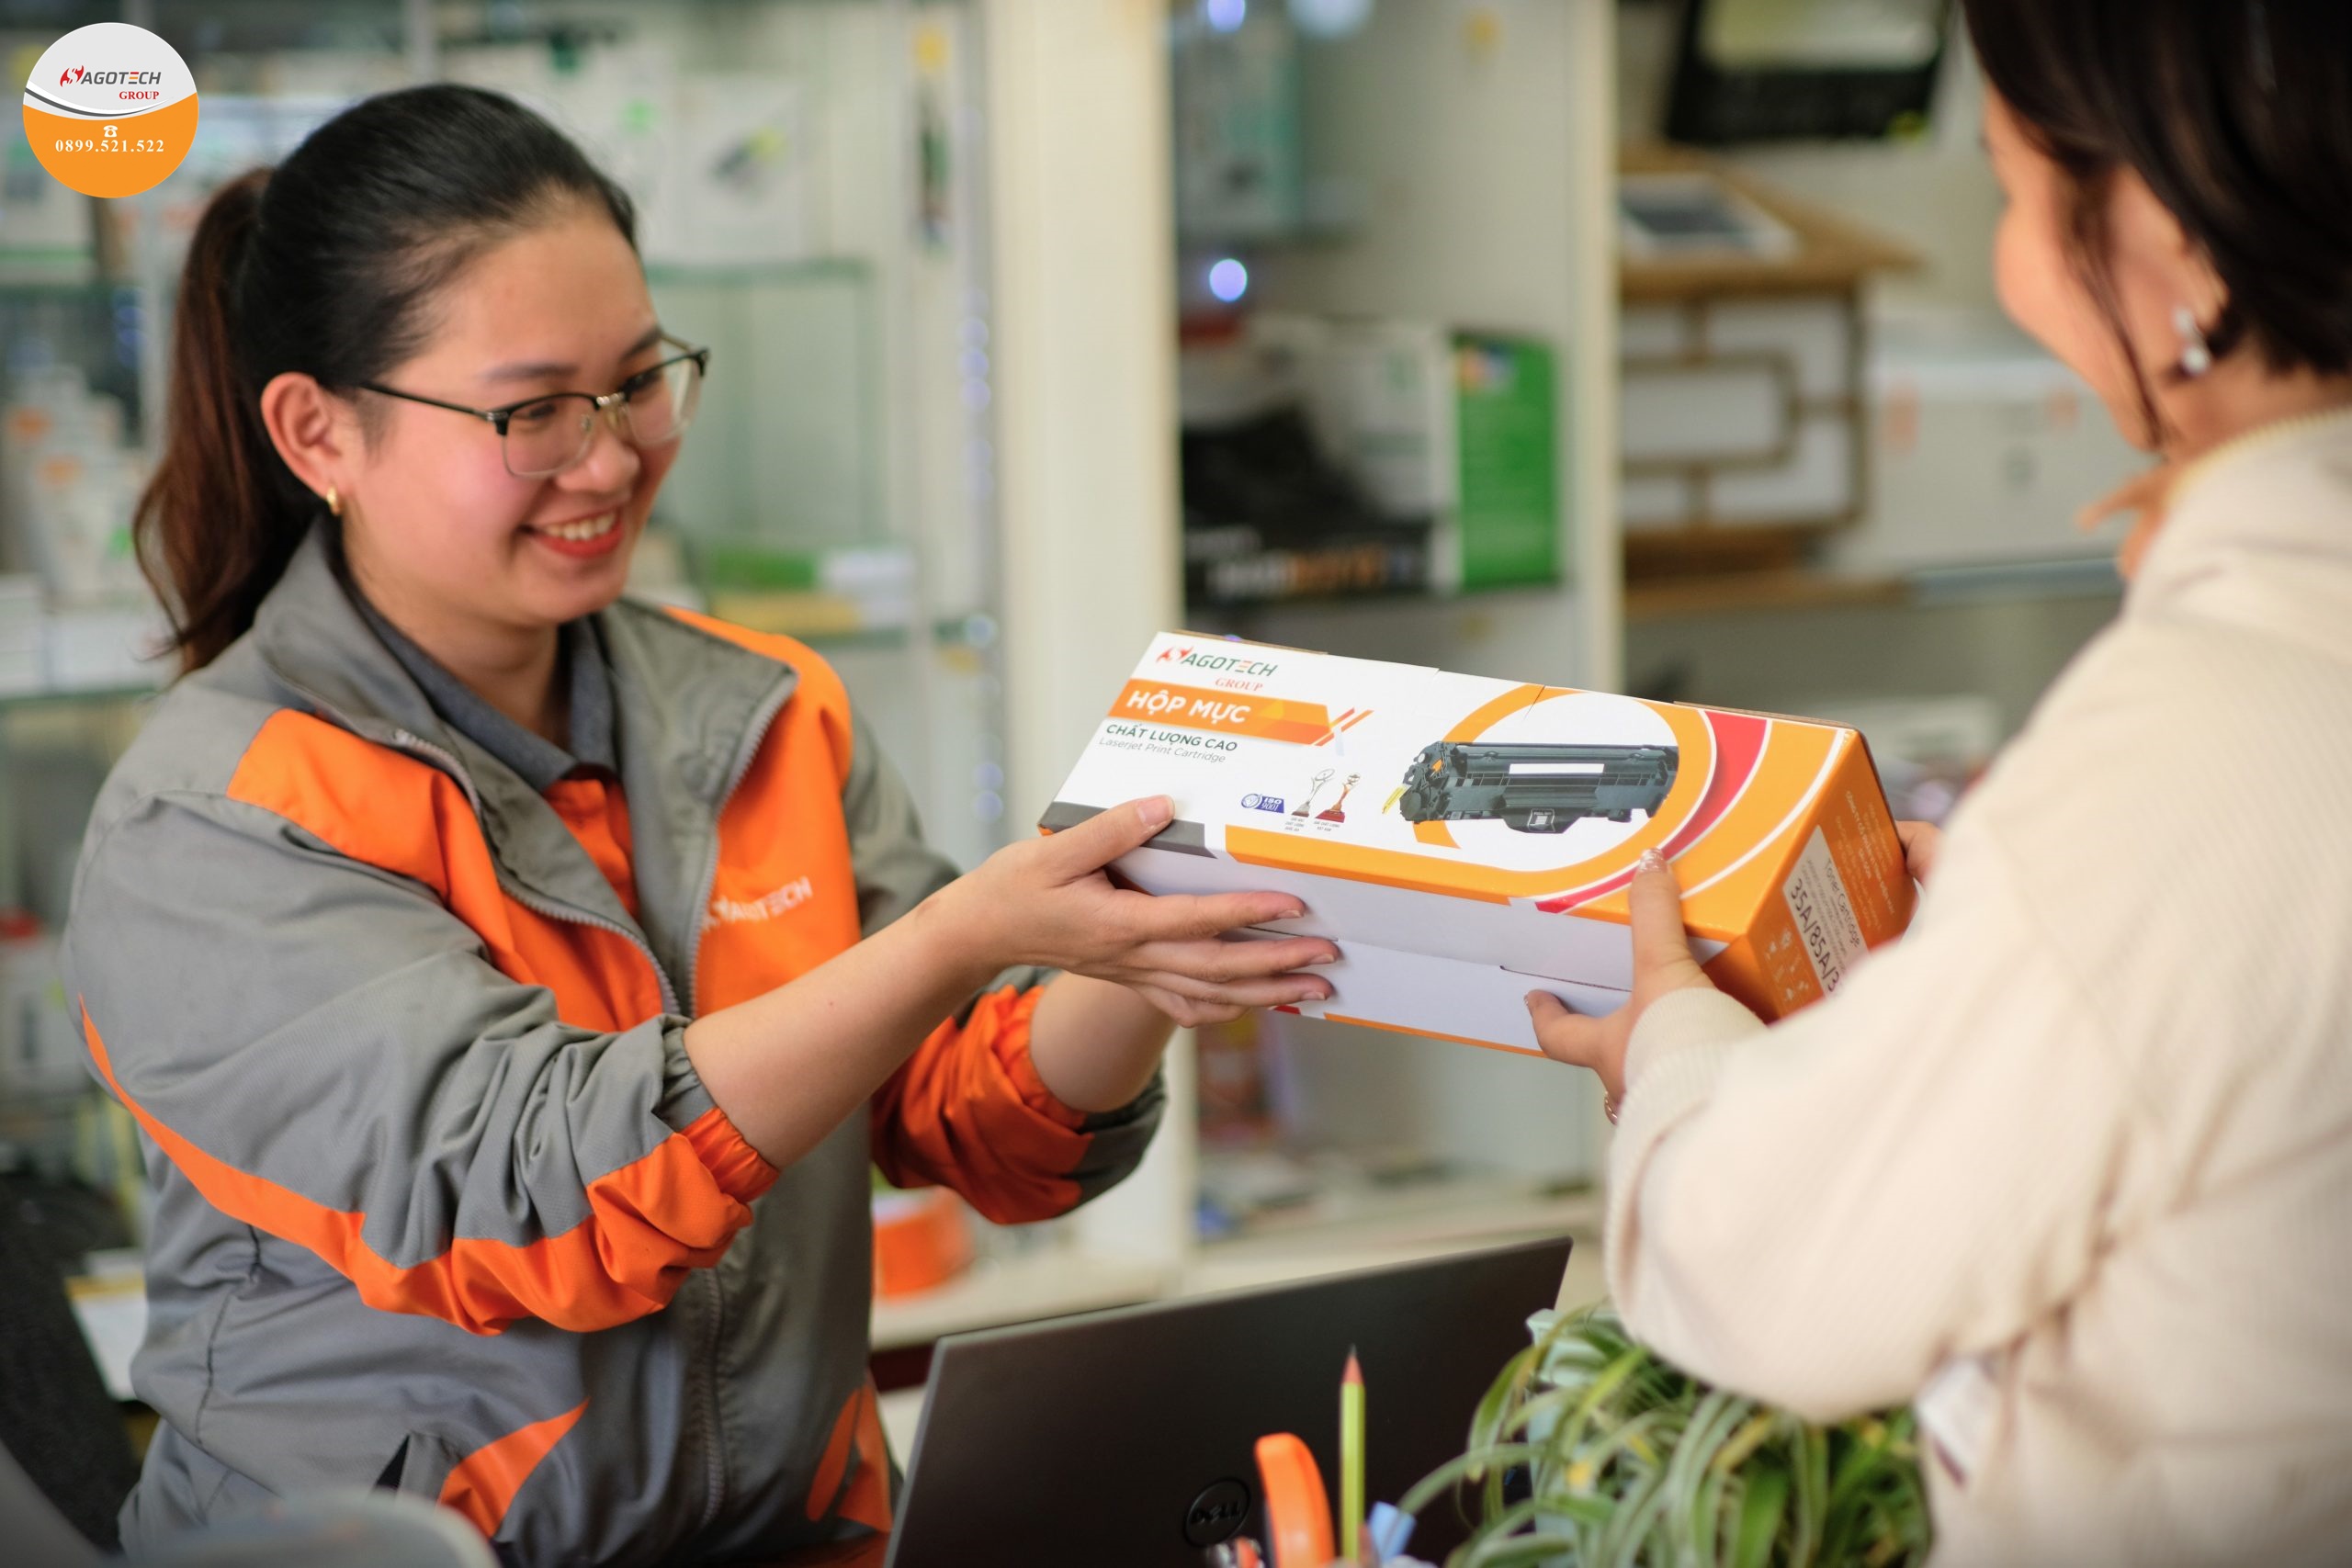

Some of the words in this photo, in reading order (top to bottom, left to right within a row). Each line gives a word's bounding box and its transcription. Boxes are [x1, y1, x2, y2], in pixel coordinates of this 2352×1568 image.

[1215, 677, 1263, 692] GROUP
[1126, 689, 1186, 716] HỘP
[1188, 699, 1250, 725] MỰC
[1099, 737, 1143, 750] Laserjet
[1145, 743, 1172, 755] Print
[1173, 747, 1226, 763] Cartridge
[1106, 723, 1148, 739] CHẤT
[1204, 738, 1238, 751] CAO
[1791, 878, 1840, 993] 35A/85A/3
[1191, 1500, 1241, 1525] DELL
